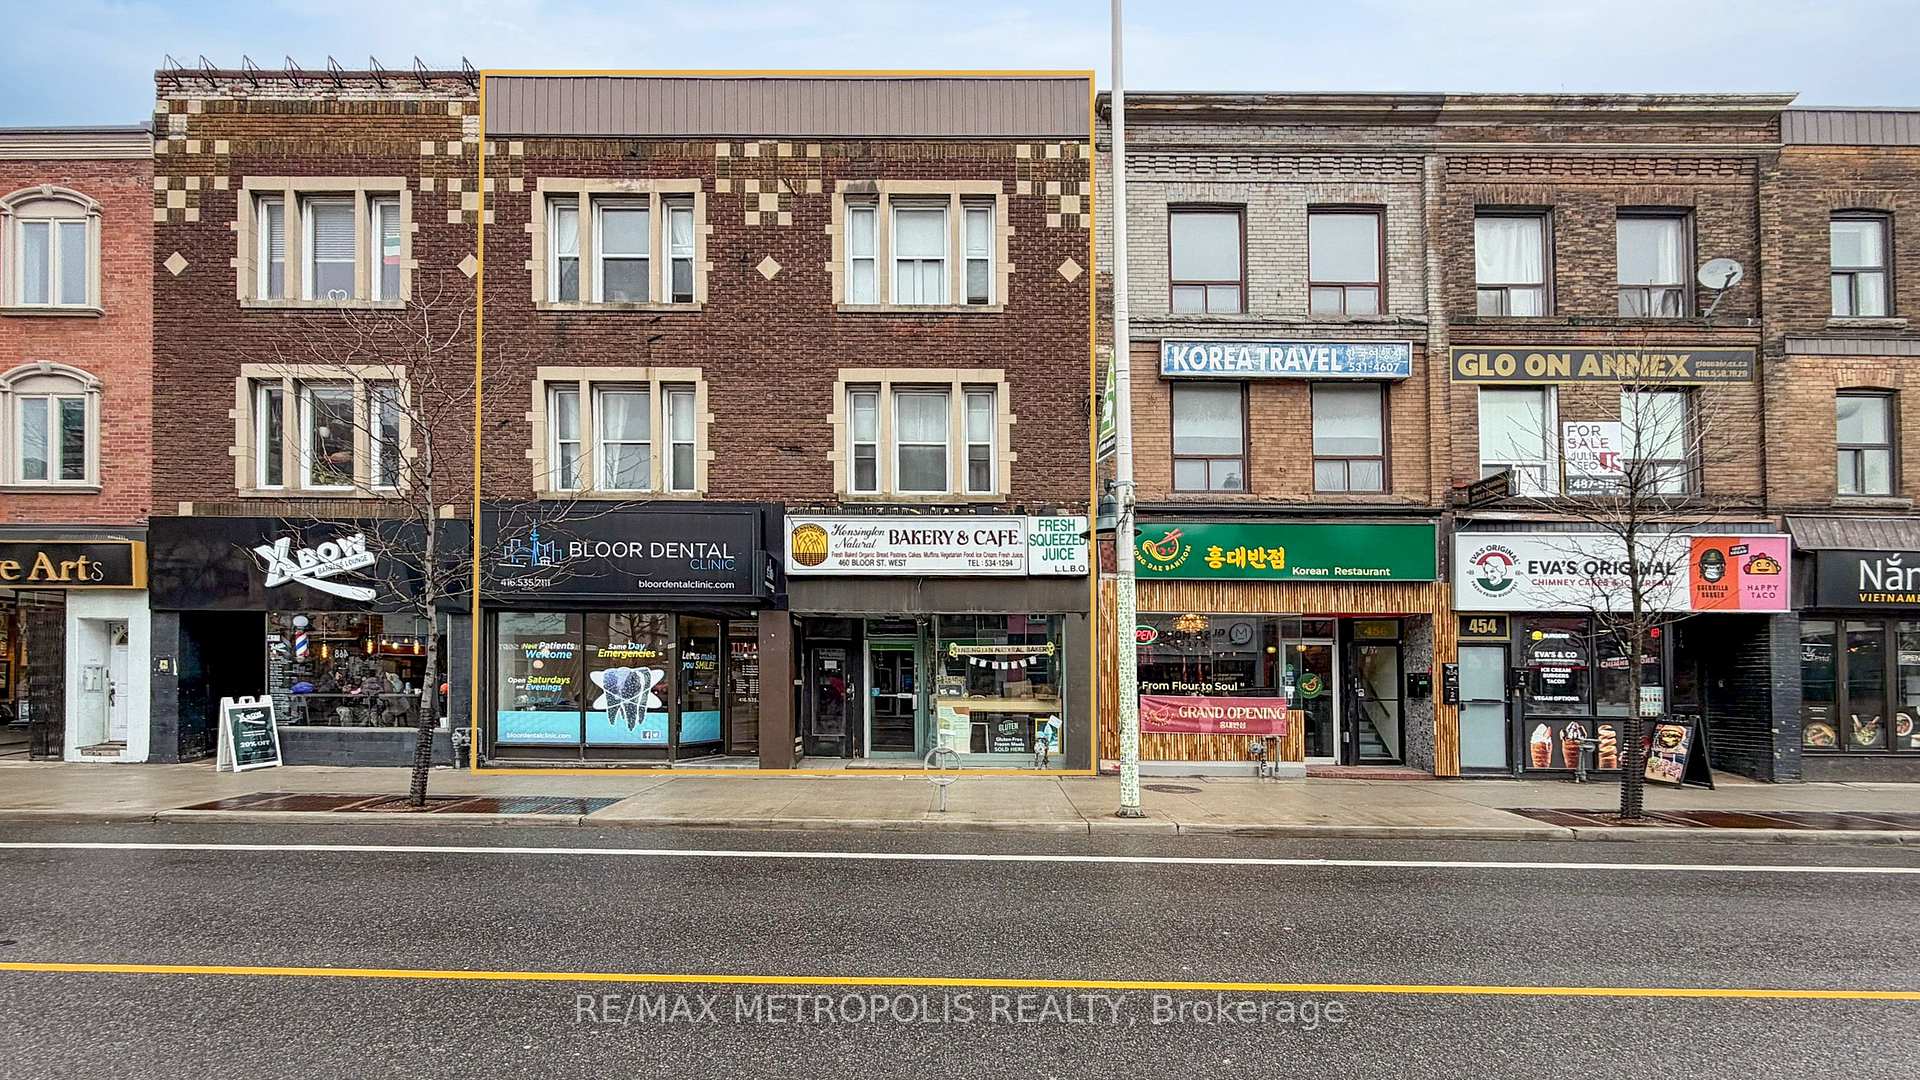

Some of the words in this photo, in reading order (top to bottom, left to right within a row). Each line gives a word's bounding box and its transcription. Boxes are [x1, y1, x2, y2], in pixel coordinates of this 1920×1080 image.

[1173, 346, 1254, 370] KOREA
[1255, 347, 1343, 371] TRAVEL
[1349, 362, 1400, 372] 531-4607
[1457, 353, 1517, 377] GLO
[1524, 353, 1571, 377] ON
[1577, 354, 1690, 378] ANNEX
[1567, 425, 1601, 436] FOR
[1567, 438, 1609, 449] SALE
[1038, 519, 1076, 531] FRESH
[835, 537, 876, 549] Natural
[888, 529, 954, 545] BAKERY
[956, 530, 969, 545] &
[973, 530, 1019, 547] CAFE
[569, 541, 643, 558] BLOOR
[650, 542, 735, 559] DENTAL
[1042, 548, 1075, 560] JUICE
[1204, 545, 1285, 569] 홍대반점
[27, 551, 104, 581] Arts
[689, 559, 735, 570] CLINIC
[838, 559, 849, 567] 460
[851, 559, 875, 567] BLOOR
[888, 559, 907, 567] WEST
[1528, 560, 1577, 575] EVA'S
[1583, 560, 1677, 575] ORIGNAL
[1292, 566, 1329, 575] Korean
[1334, 567, 1391, 576] Restaurant
[638, 579, 736, 589] bloordentalclinic.com
[1531, 578, 1576, 586] CHIMNEY
[1469, 618, 1498, 634] 454
[1136, 629, 1155, 640] PEN
[538, 641, 575, 650] Patients
[627, 642, 646, 651] Day
[597, 648, 656, 659] Emergencies
[527, 675, 571, 685] Saturdays
[525, 683, 562, 692] Evenings
[1142, 681, 1170, 690] From
[1171, 681, 1201, 690] Flour
[1201, 682, 1212, 691] to
[1214, 681, 1238, 691] Soul
[1178, 705, 1224, 719] GRAND
[1226, 706, 1286, 720] OPENING
